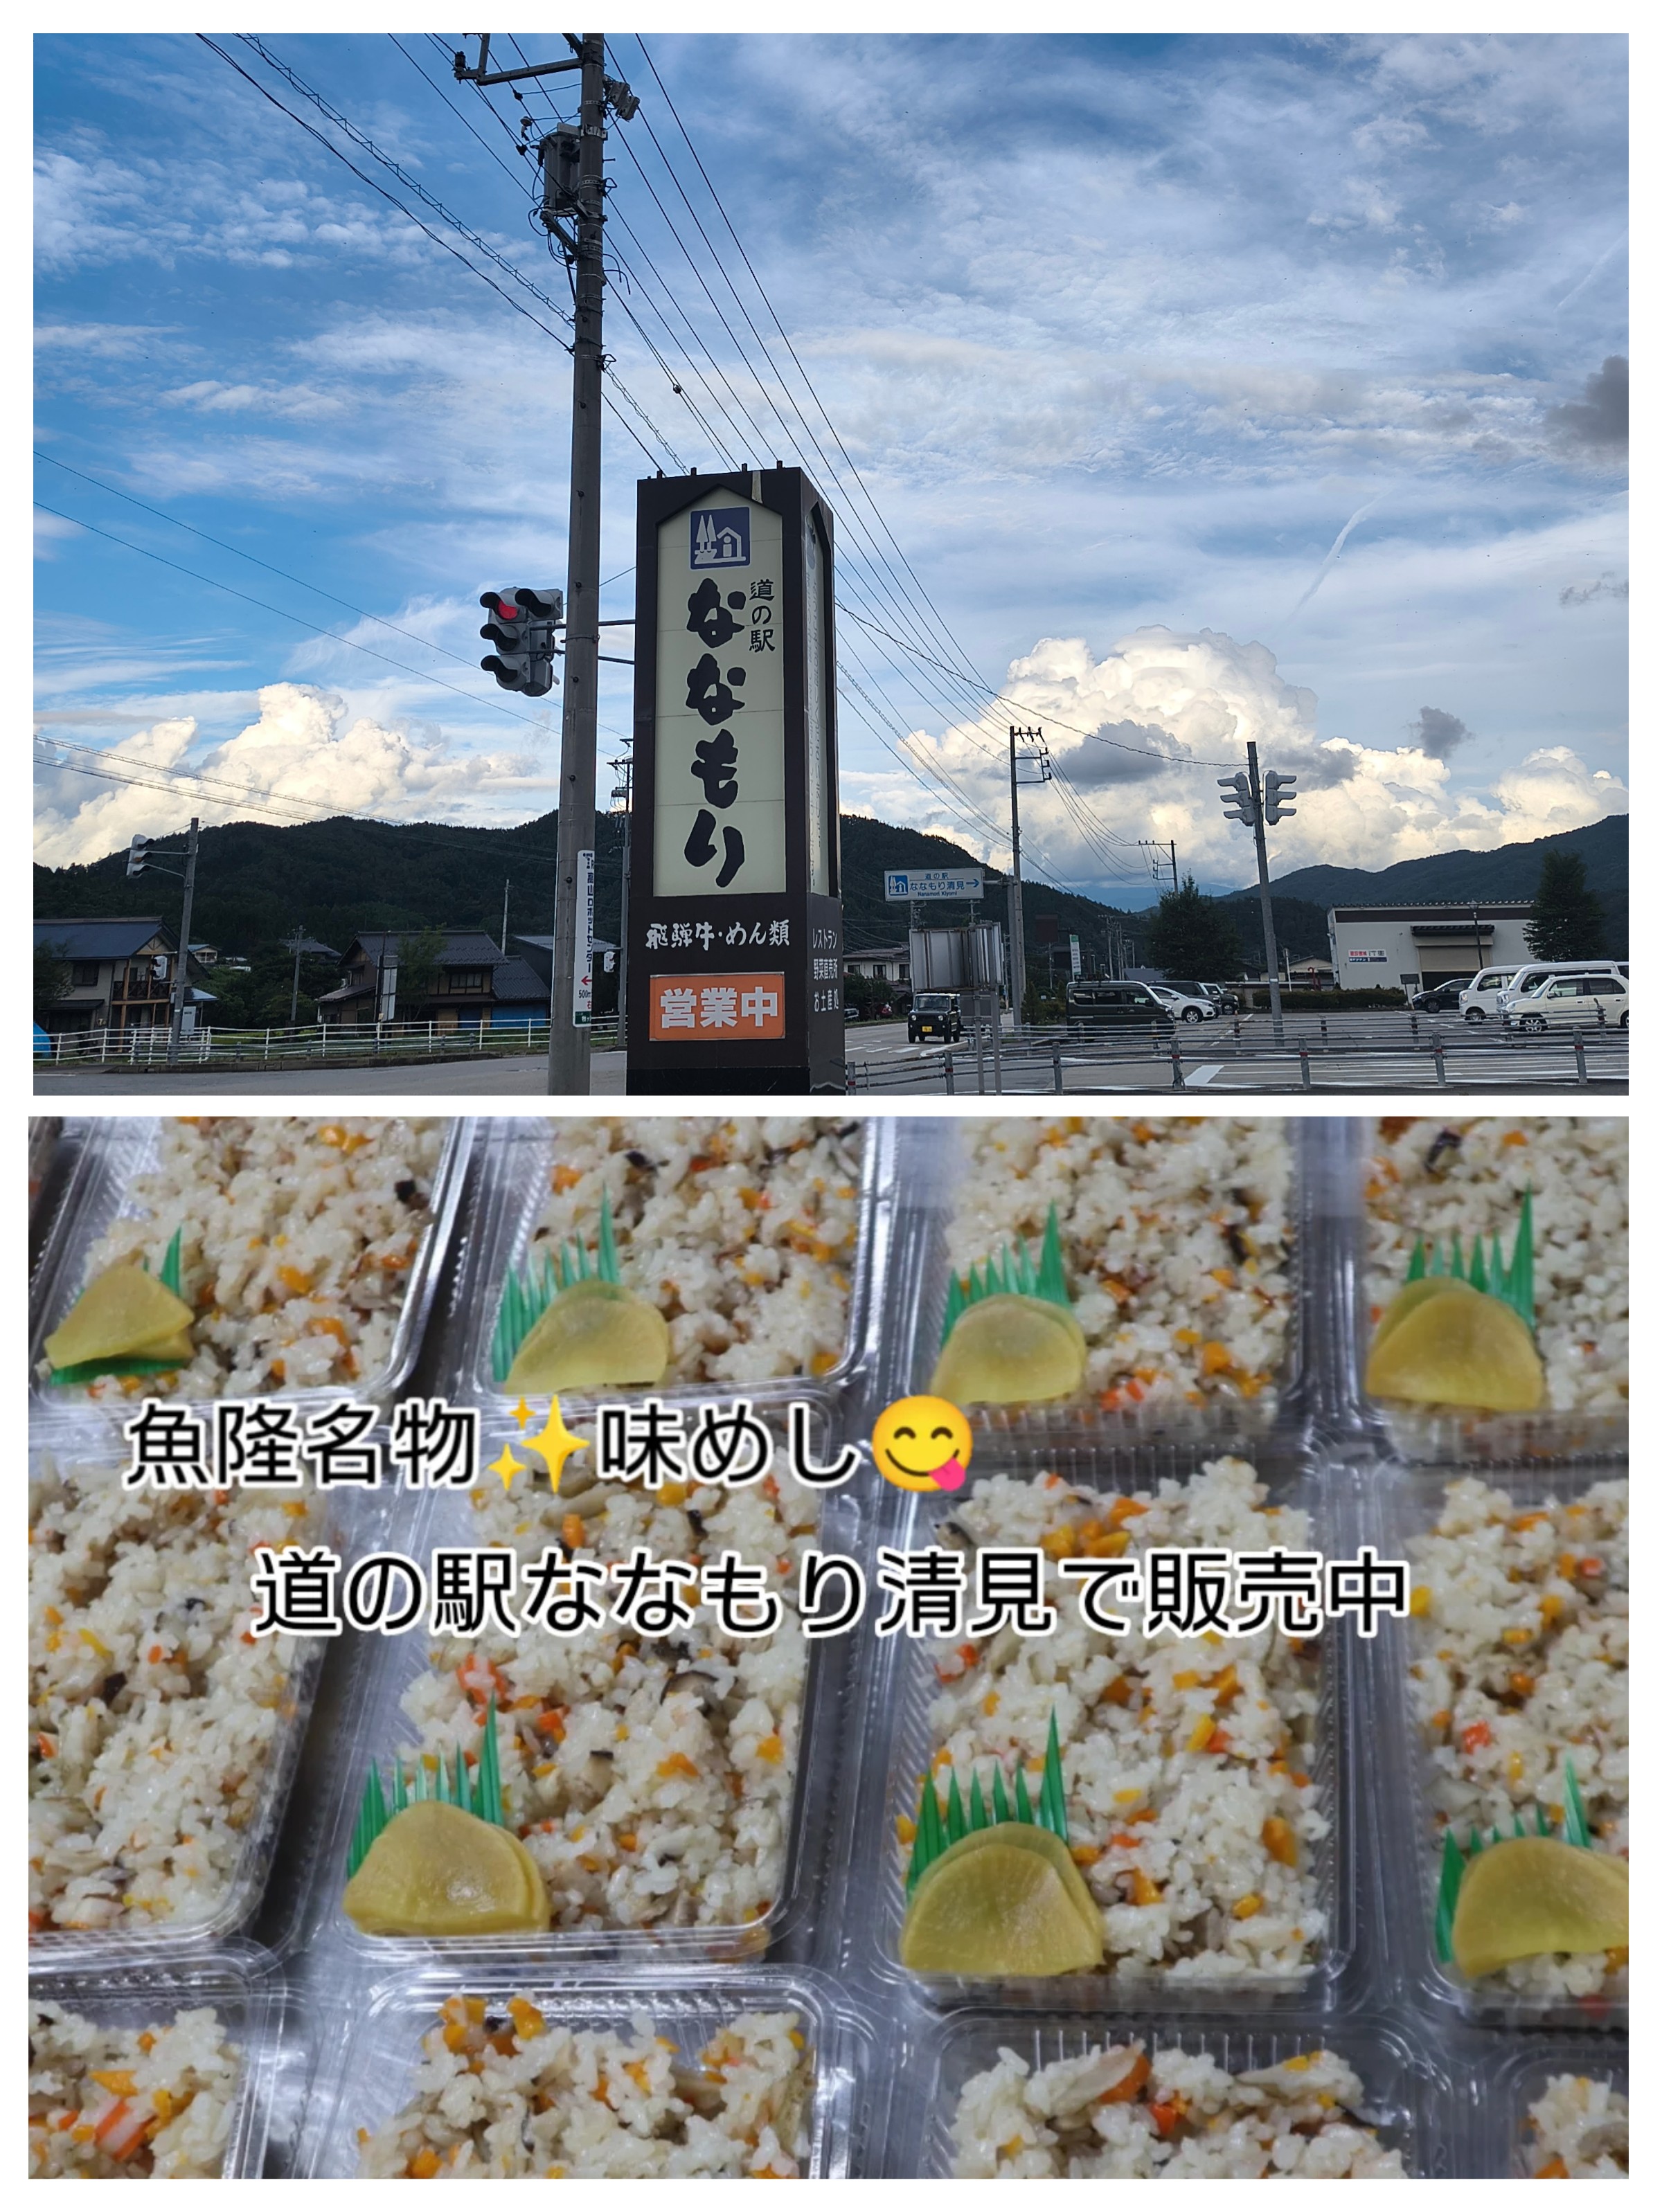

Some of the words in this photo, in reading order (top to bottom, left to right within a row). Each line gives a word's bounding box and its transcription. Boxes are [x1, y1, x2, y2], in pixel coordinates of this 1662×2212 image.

[748, 579, 776, 654] 道の駅
[685, 577, 746, 888] ななもり
[909, 881, 965, 891] ななもり清見
[812, 928, 838, 951] レストラン
[813, 958, 839, 981] 野菜直売所
[660, 986, 778, 1029] 営業中
